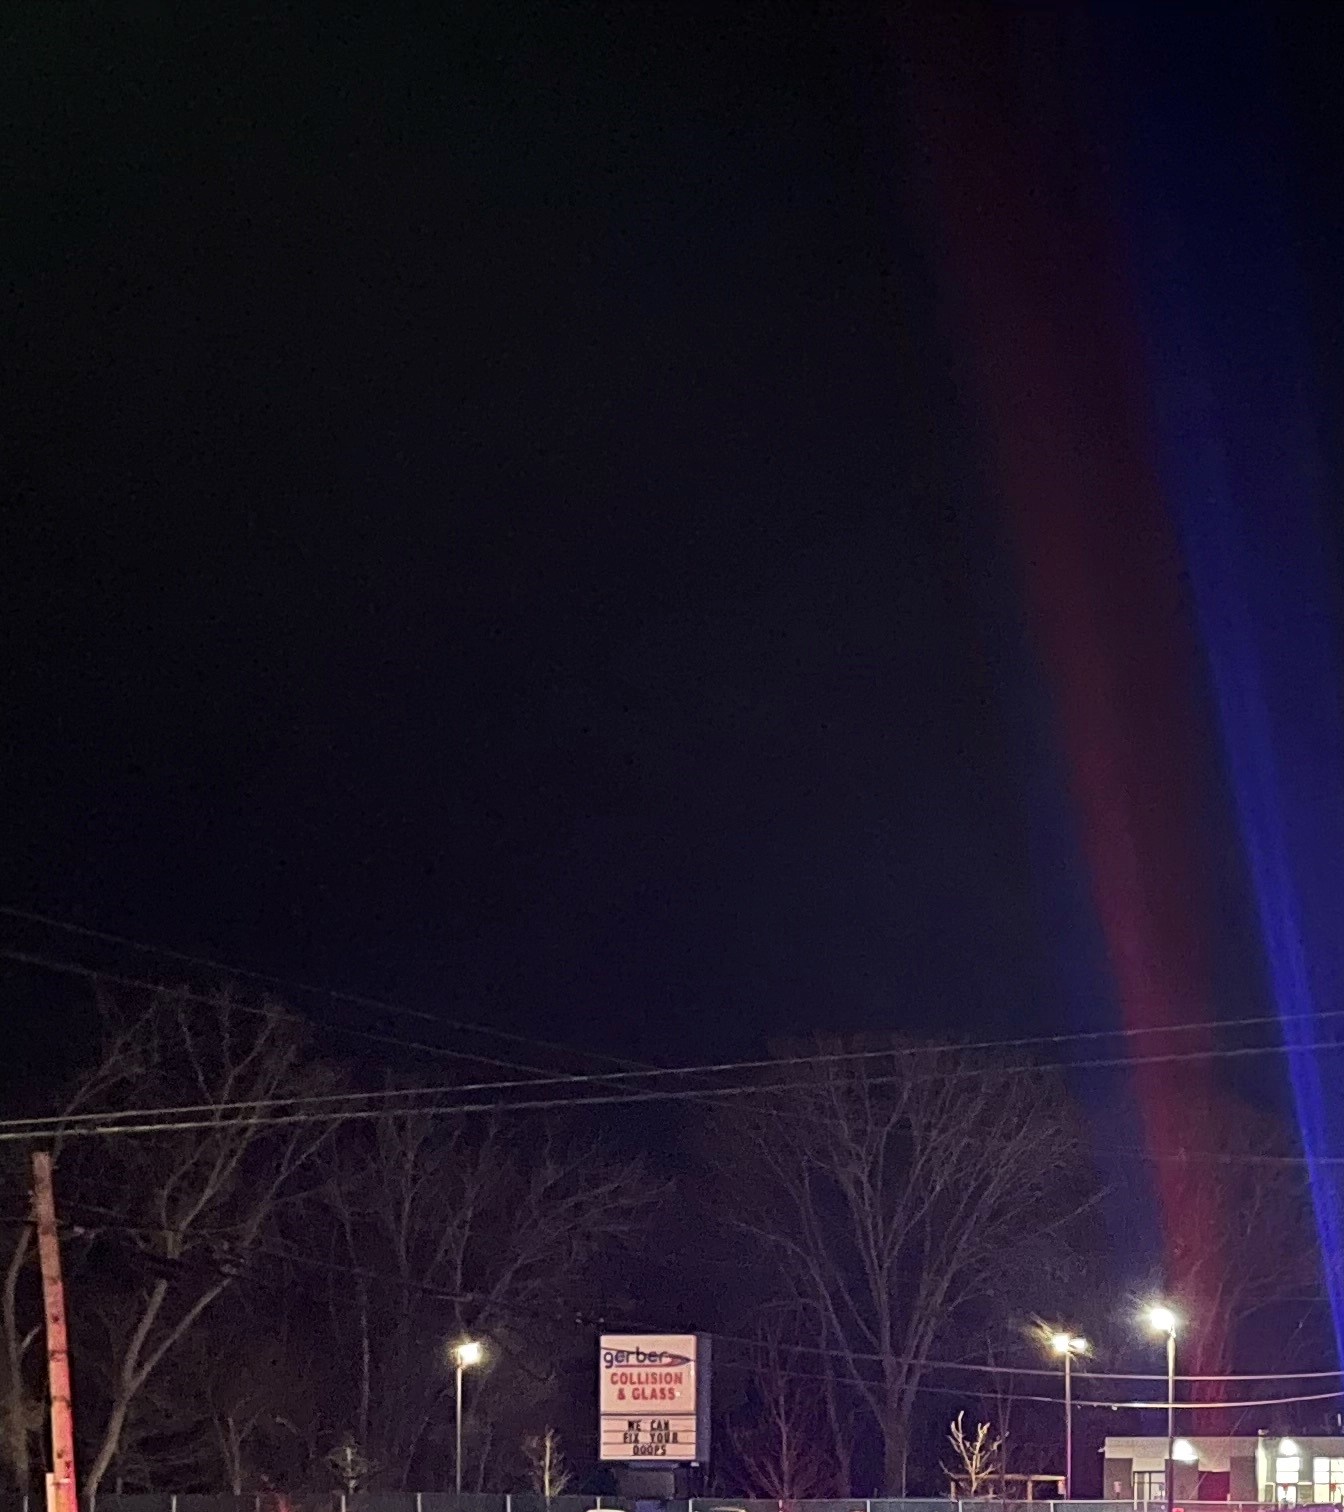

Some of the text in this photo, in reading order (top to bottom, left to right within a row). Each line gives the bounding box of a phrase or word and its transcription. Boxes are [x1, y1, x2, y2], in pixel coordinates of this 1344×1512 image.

[604, 1347, 668, 1369] gerber
[610, 1372, 683, 1385] COLLISION
[617, 1388, 676, 1400] & GLASS
[628, 1420, 669, 1431] WE CAN
[623, 1432, 678, 1443] FIX YOUR
